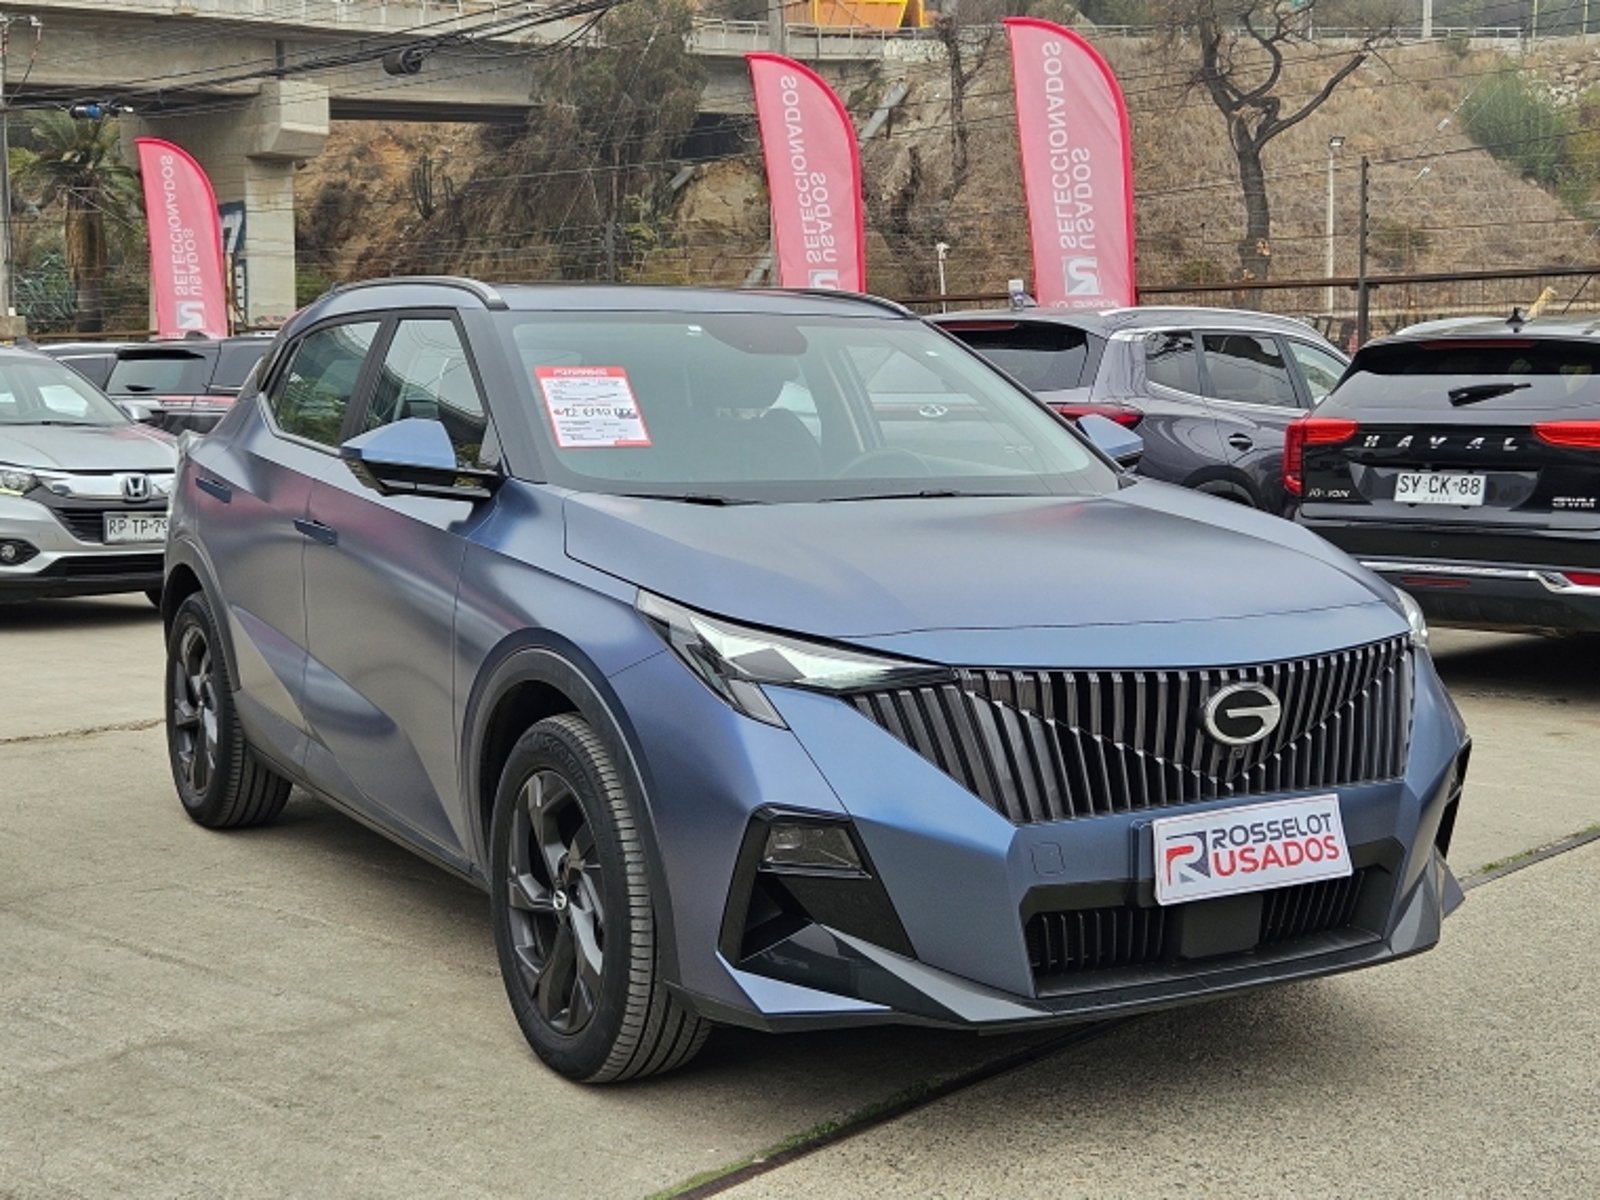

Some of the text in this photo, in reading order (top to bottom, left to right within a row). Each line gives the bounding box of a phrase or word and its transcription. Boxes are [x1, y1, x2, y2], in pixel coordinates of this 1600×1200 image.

[1363, 435, 1519, 451] HAVAL
[1211, 813, 1332, 849] ROSSELOT
[1213, 835, 1340, 877] USADOS
